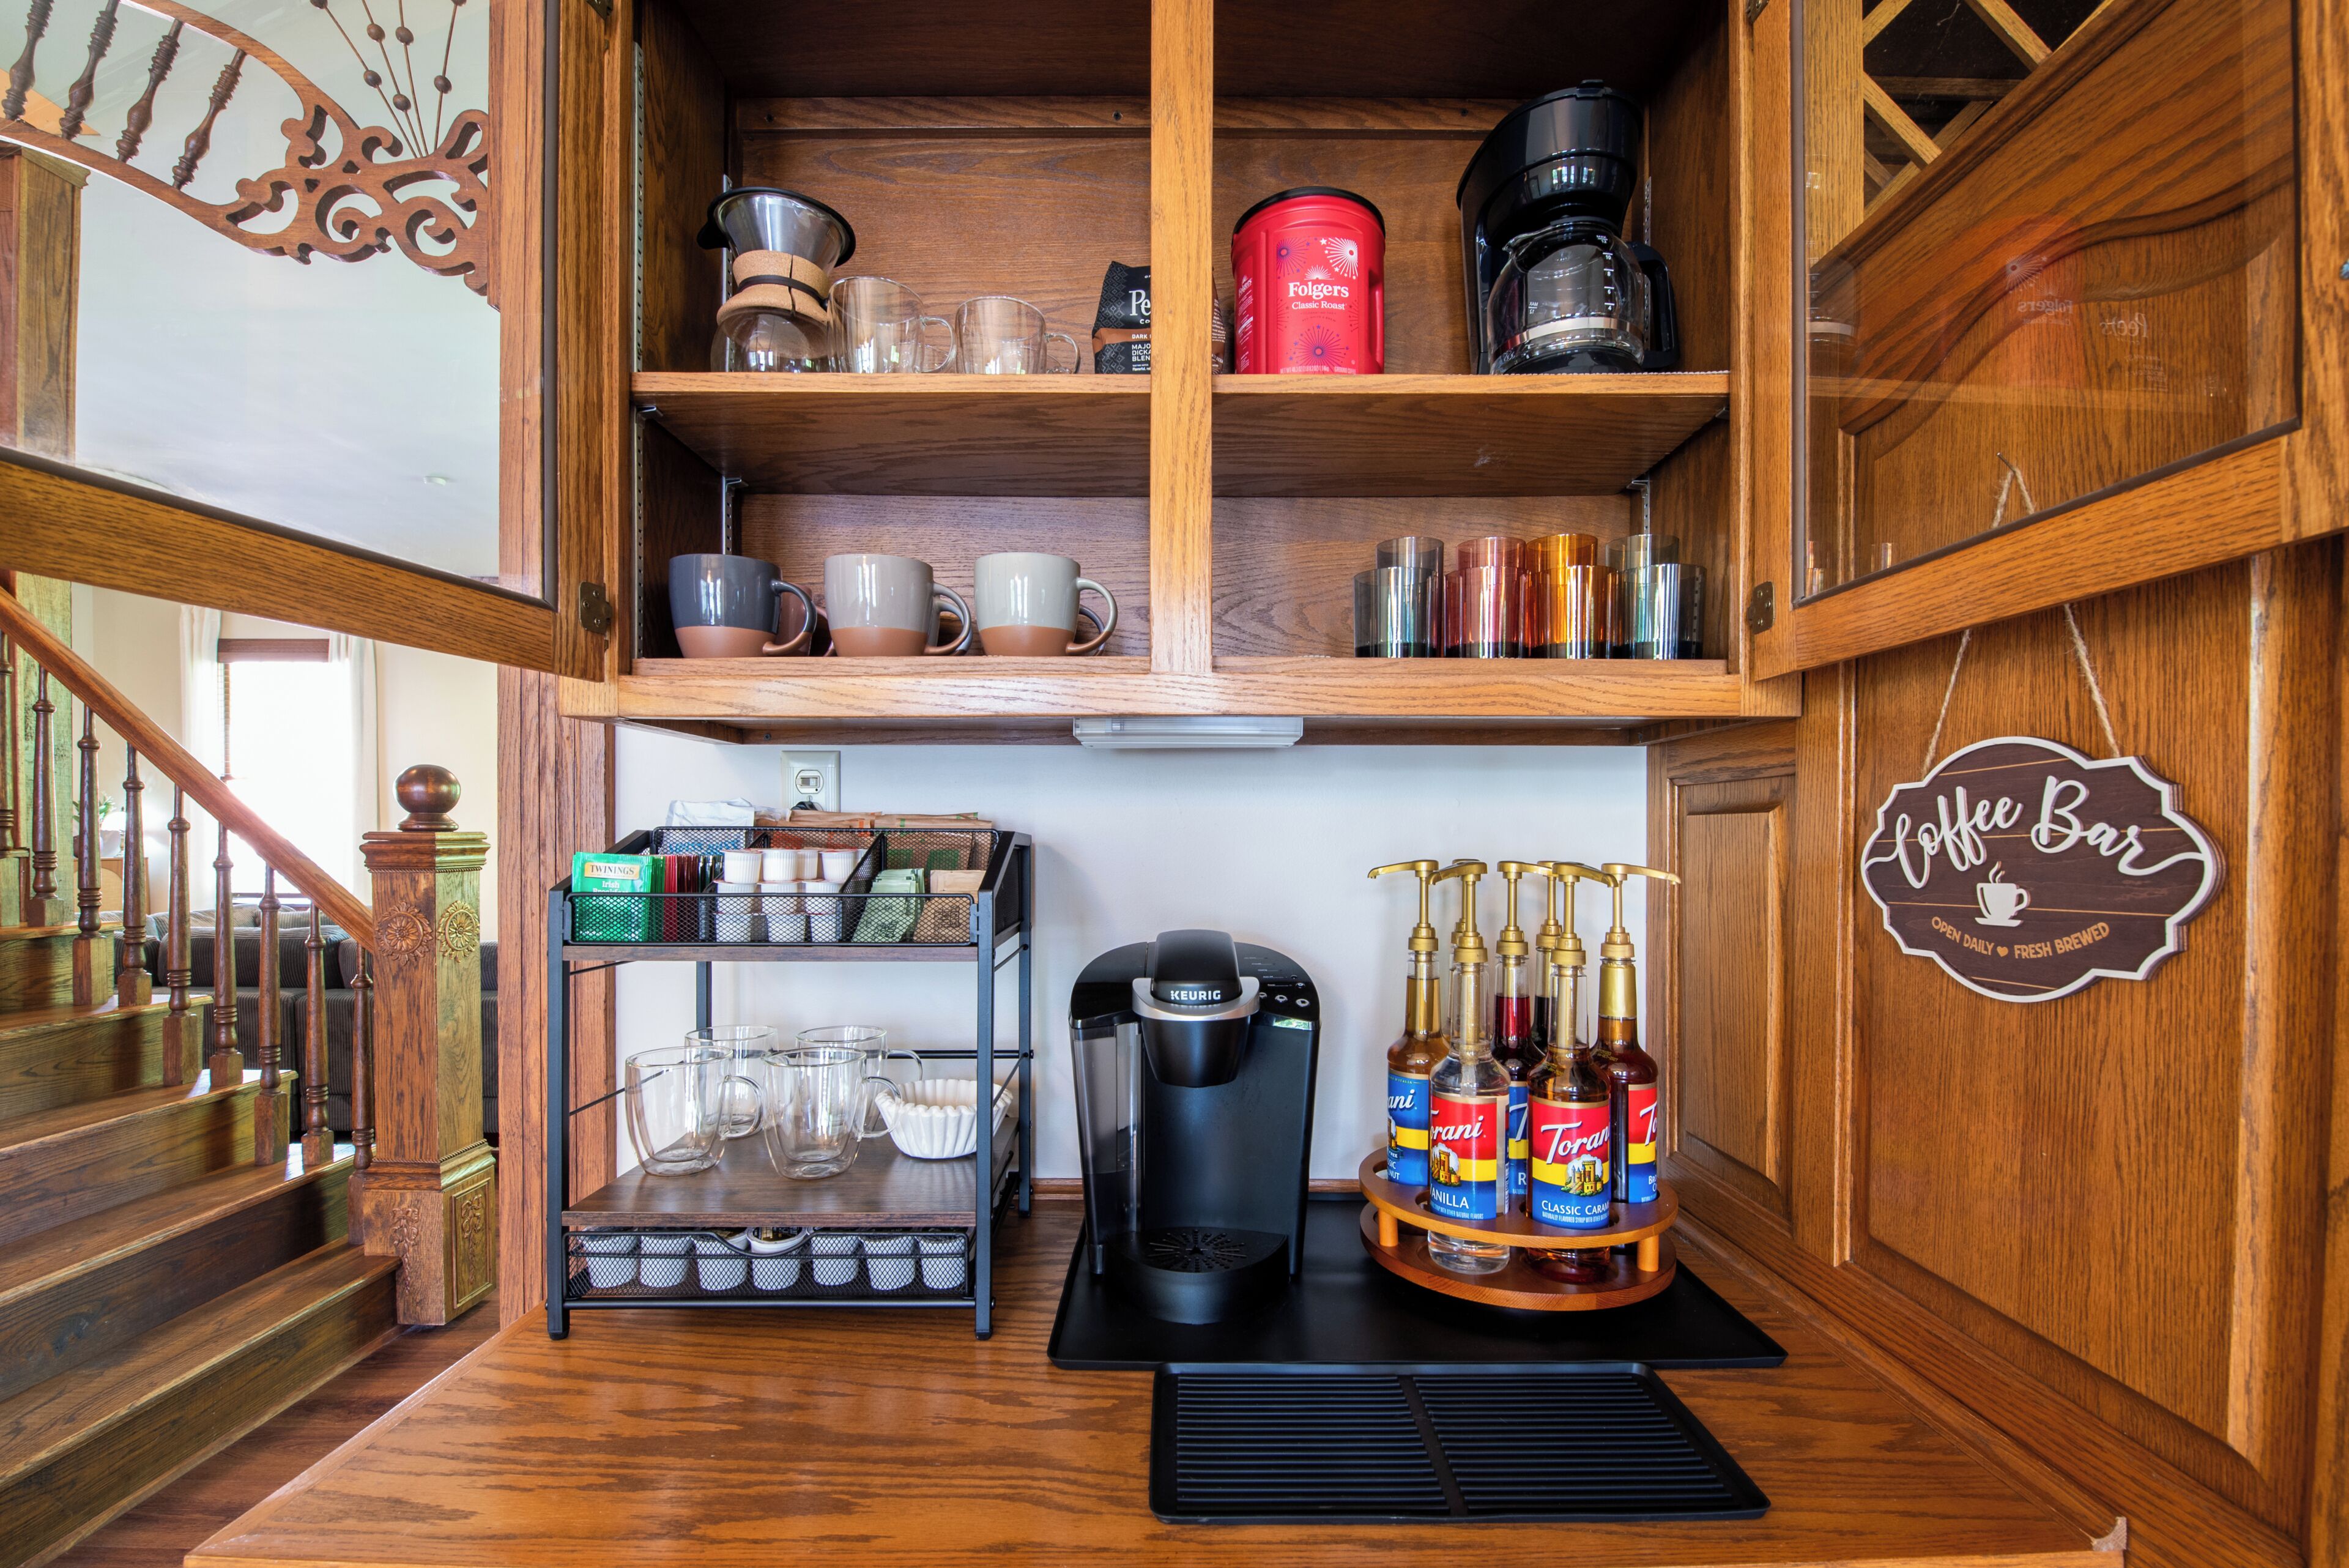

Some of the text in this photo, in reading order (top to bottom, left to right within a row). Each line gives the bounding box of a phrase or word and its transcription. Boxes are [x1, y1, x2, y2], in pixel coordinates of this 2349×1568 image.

[1288, 281, 1349, 300] Folgers
[1291, 300, 1345, 310] Classic Roast
[1866, 776, 2202, 888] Coffee Bar
[590, 864, 634, 875] TWININGS
[602, 880, 620, 889] Irish
[1931, 916, 2109, 959] OPEN DAILY FRESH BREWED
[1170, 990, 1221, 1000] KEURIG
[1542, 1200, 1581, 1215] CLASSIC
